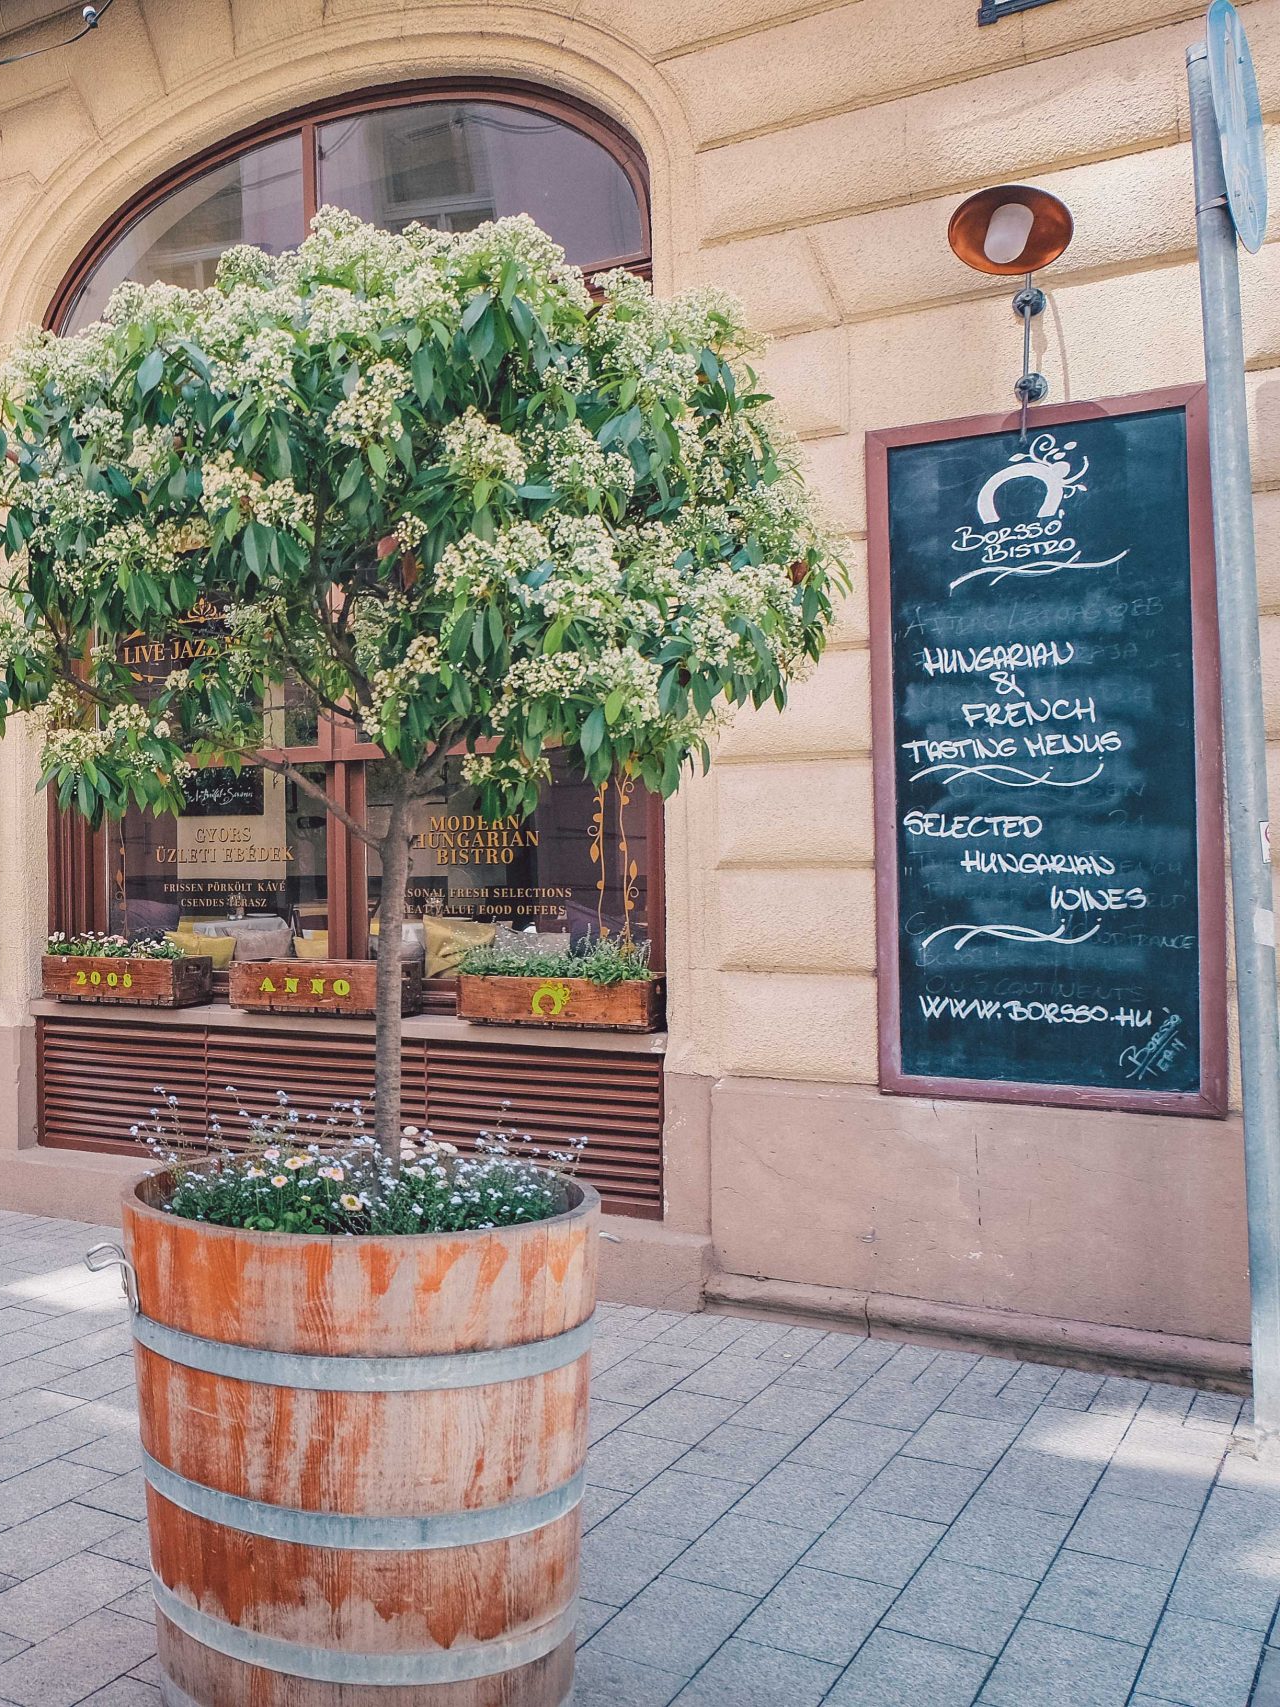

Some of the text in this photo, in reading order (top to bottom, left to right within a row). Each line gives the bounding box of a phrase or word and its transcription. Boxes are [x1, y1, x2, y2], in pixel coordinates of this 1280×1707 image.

[981, 537, 1076, 563] BISTRO
[124, 643, 165, 664] LIVE
[170, 638, 218, 660] JAZZ
[923, 641, 1075, 676] HUNGARIAN
[989, 670, 1025, 697] &
[961, 697, 1096, 727] FRENCH
[902, 731, 1122, 763] TASTING MENUS
[430, 814, 520, 832] MODERN
[903, 811, 1042, 838] SELECTED
[195, 827, 252, 843] GYORS
[412, 831, 540, 849] HUNGARIAN
[155, 844, 295, 864] ÜZLETI EBÉDEK
[436, 848, 514, 866] BISTRO
[960, 850, 1116, 875] HUNGARIAN
[164, 881, 286, 892] FRISSEN PÖRKÖLT KÁVÉ
[403, 888, 572, 898] SONAL FRESH SELECTIONS
[180, 898, 225, 907] CSENDES
[1050, 885, 1147, 911] WINES
[403, 905, 566, 915] REAT VALUE FOOD OFFERS
[76, 971, 132, 988] 2008
[259, 977, 350, 996] ANNO
